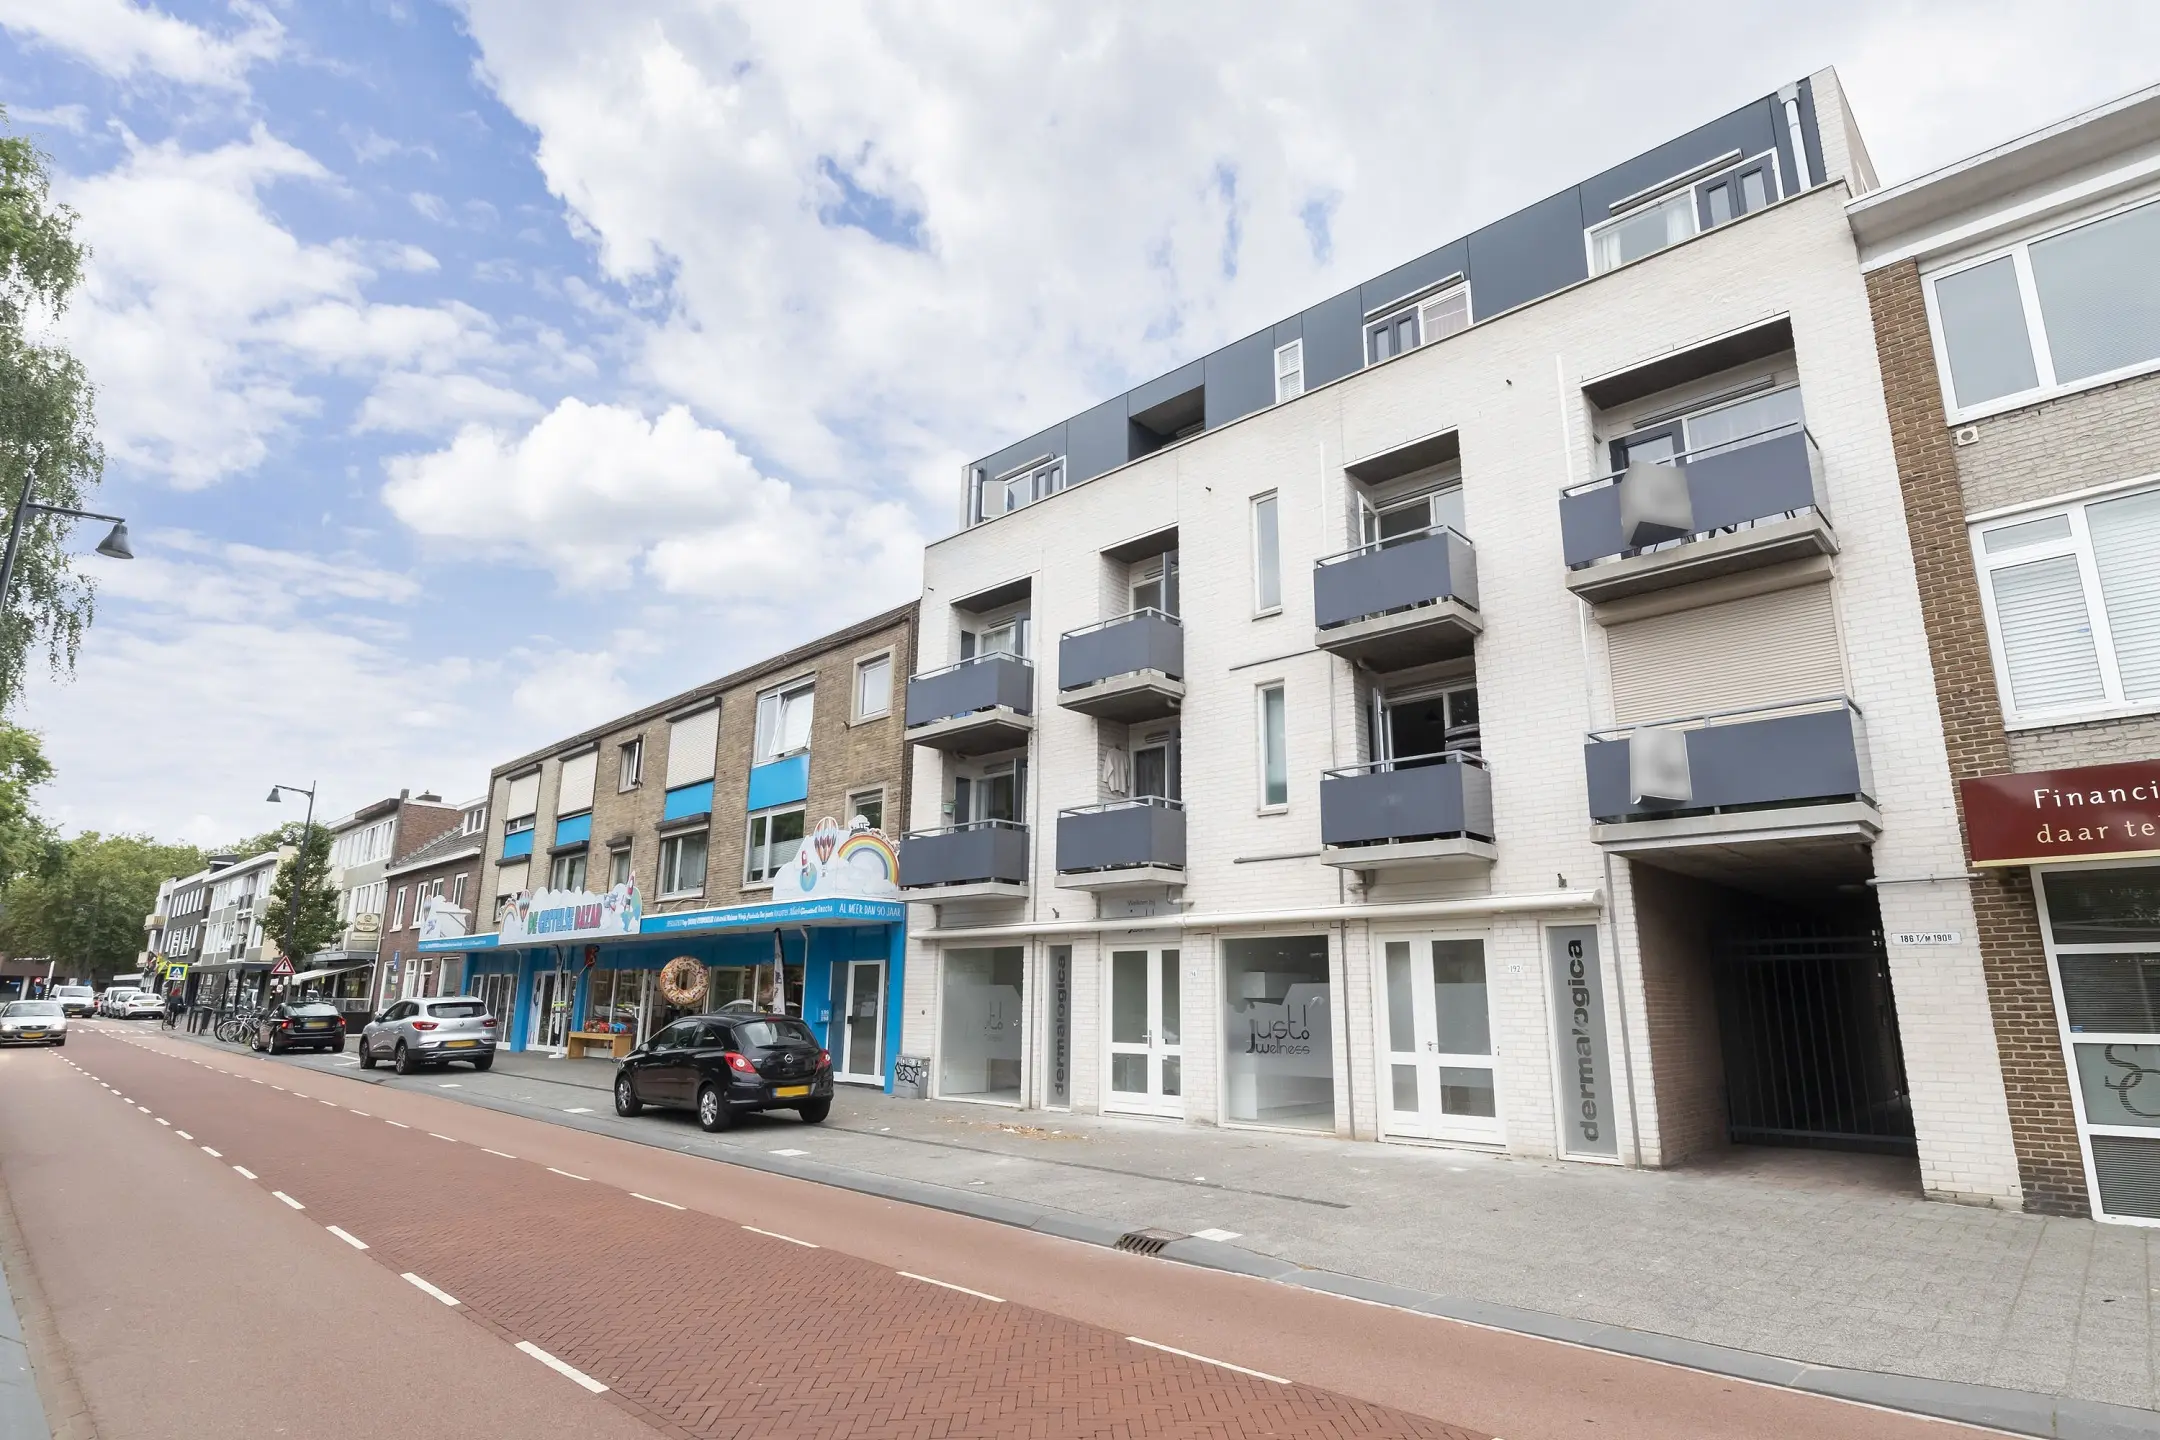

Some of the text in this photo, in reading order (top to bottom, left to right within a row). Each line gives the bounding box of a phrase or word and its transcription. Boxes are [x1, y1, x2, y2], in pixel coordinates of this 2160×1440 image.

[2033, 780, 2160, 809] Financi
[2036, 815, 2160, 843] daar te
[527, 902, 603, 935] DE GESTELSE BAZAR
[839, 903, 901, 917] AL MEER DAN 90 JAAR
[1900, 935, 1914, 943] 186
[1510, 965, 1521, 973] 192
[1055, 955, 1067, 1098] dermalogica
[1568, 940, 1599, 1142] dermalogica
